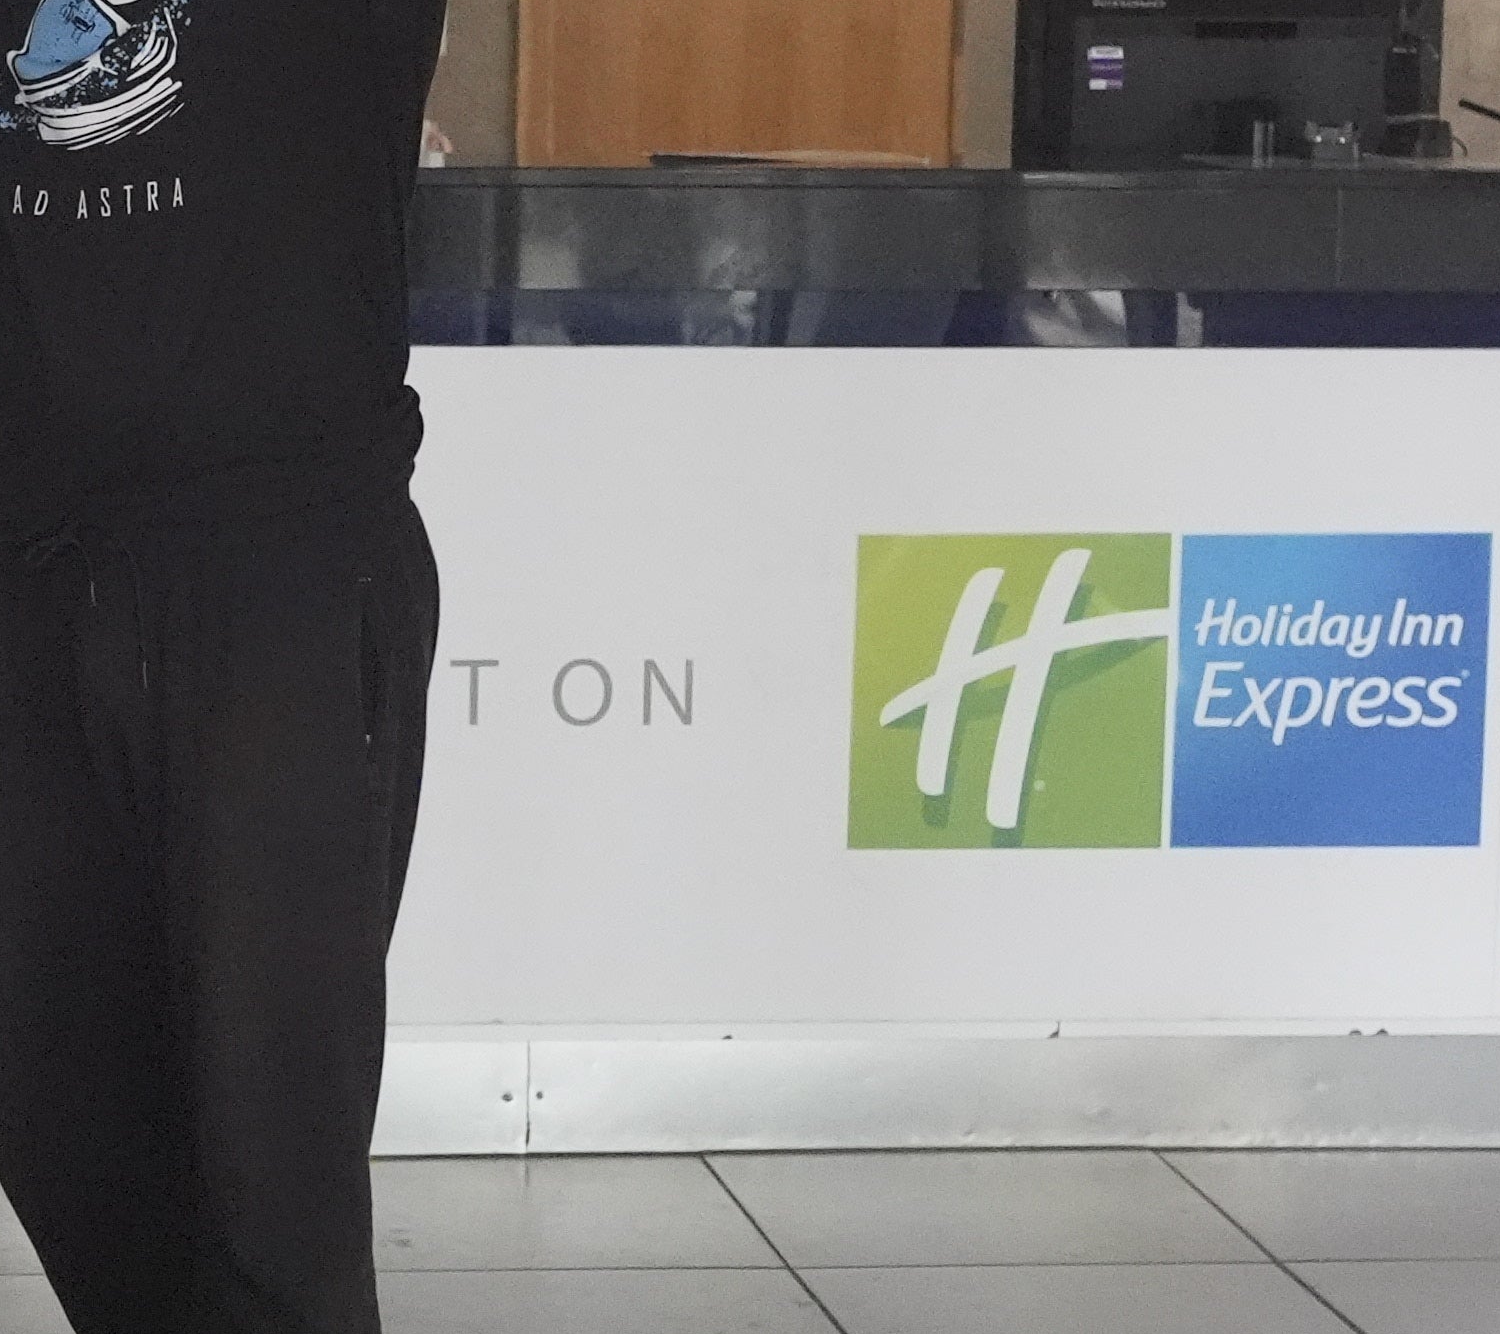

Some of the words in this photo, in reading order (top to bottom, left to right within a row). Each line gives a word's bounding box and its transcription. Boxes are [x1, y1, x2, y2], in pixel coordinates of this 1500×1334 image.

[12, 184, 49, 217] AD
[77, 177, 184, 220] ASTRA
[1193, 598, 1383, 658] Holiday
[1387, 597, 1464, 646] Inn
[1192, 661, 1463, 746] Express
